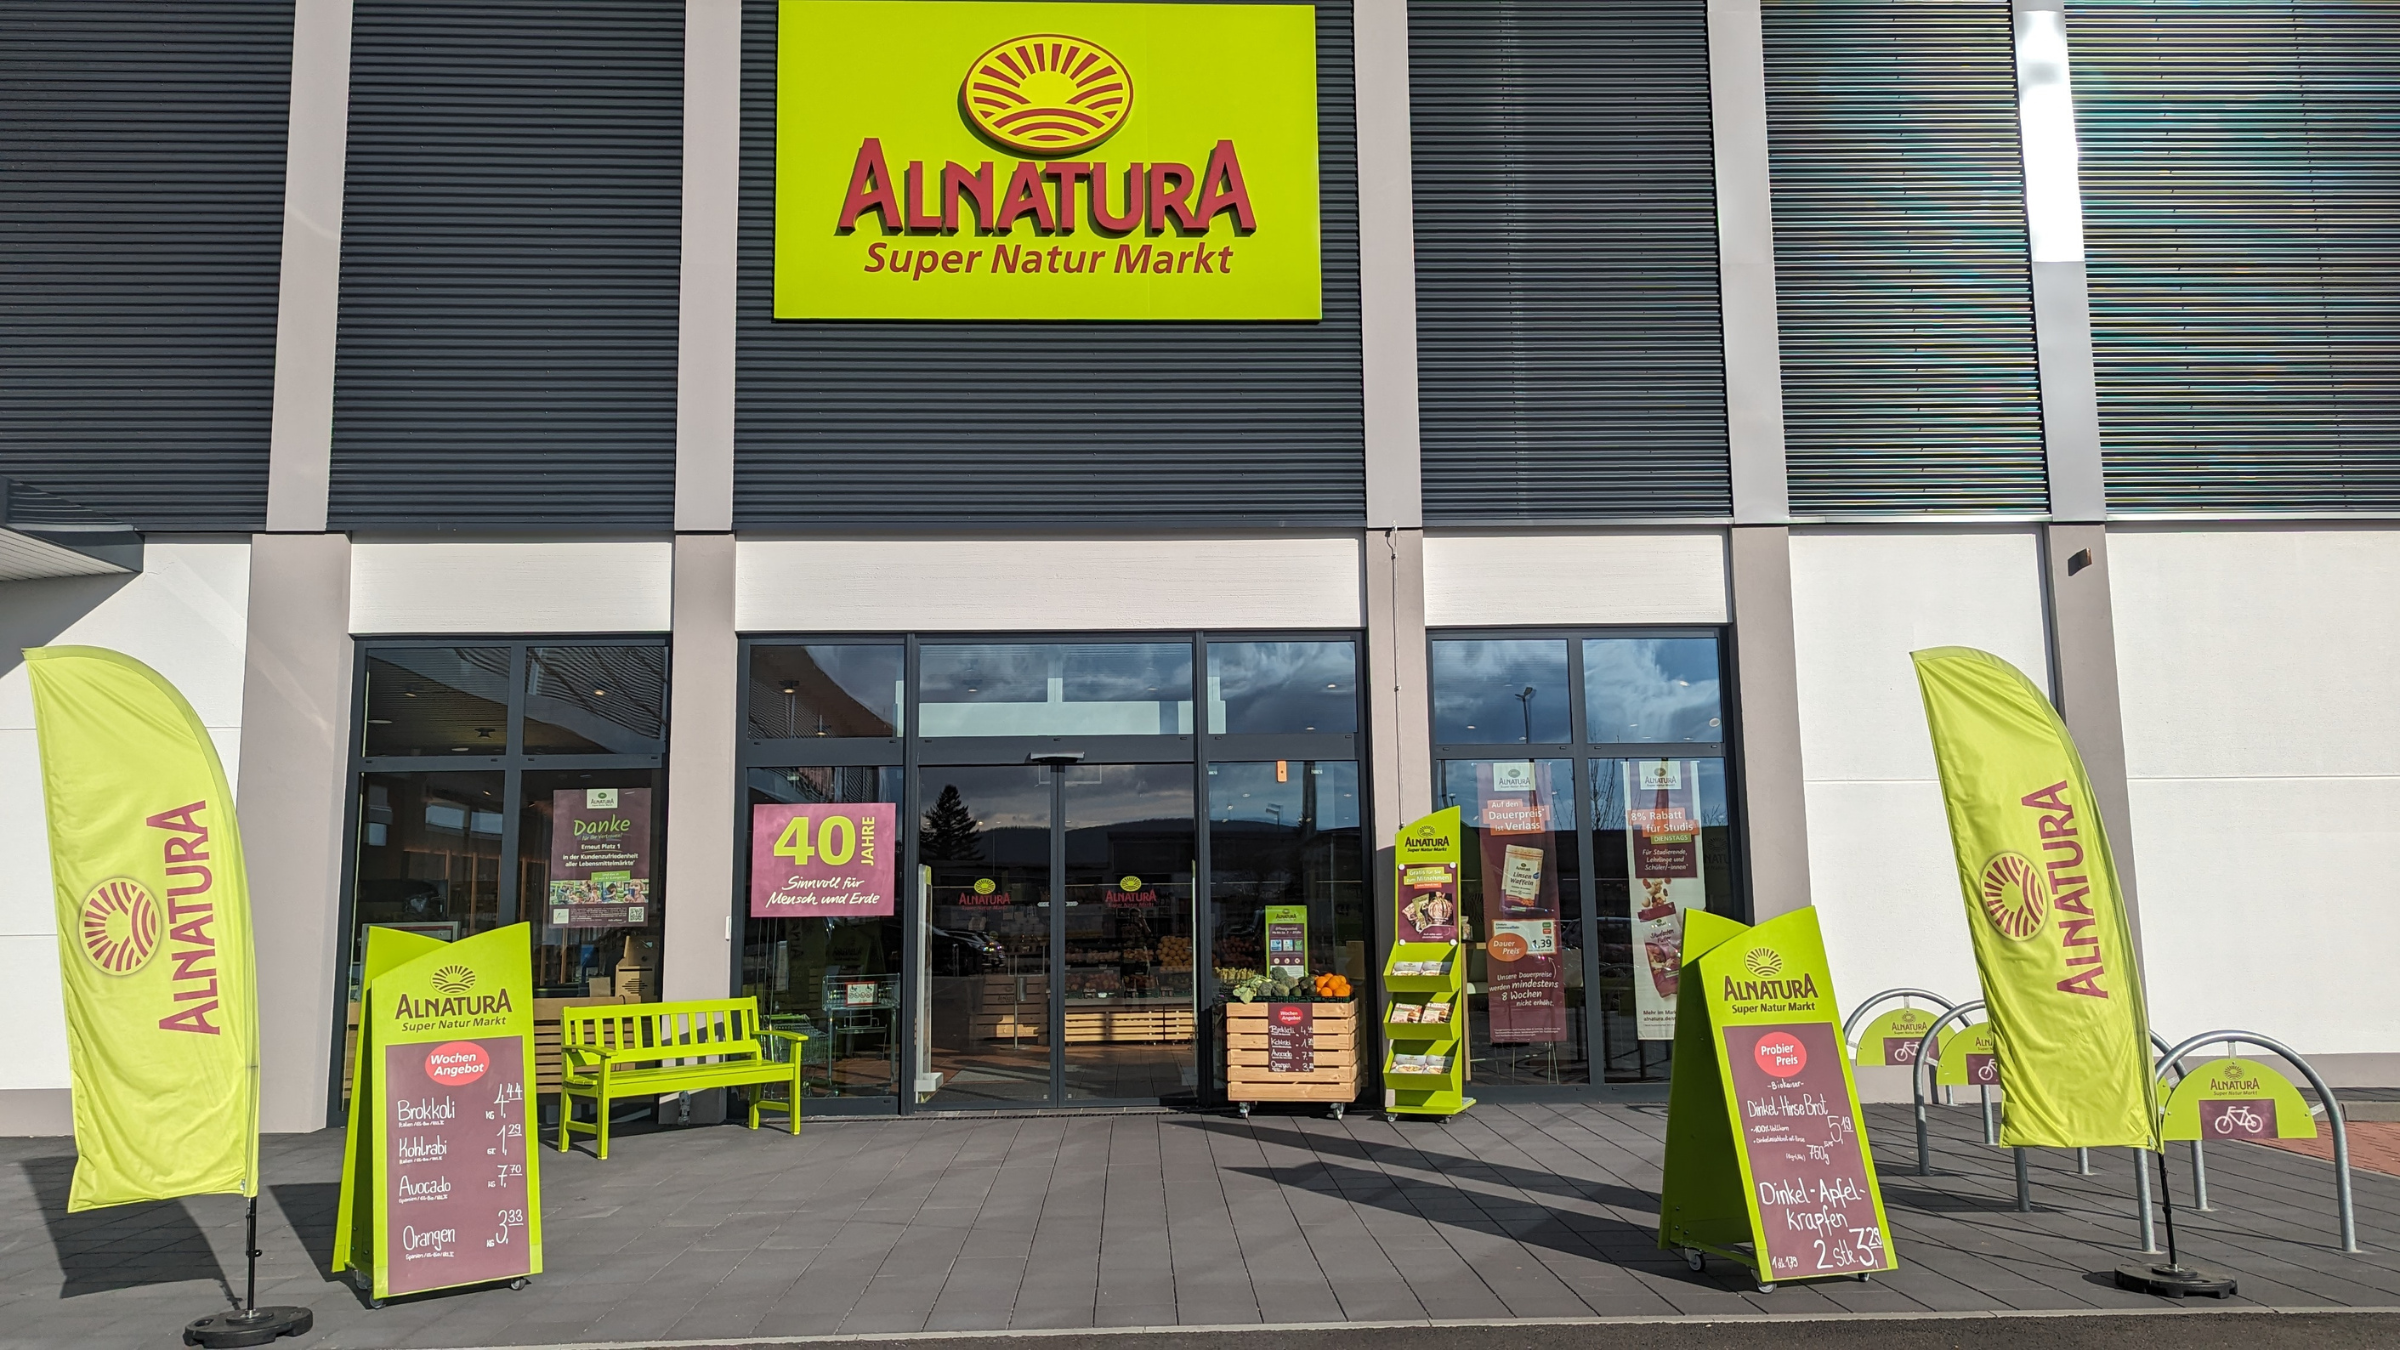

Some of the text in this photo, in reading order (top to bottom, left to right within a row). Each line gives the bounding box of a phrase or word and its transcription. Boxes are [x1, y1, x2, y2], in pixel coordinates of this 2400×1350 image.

[838, 137, 1256, 232] ALNATURA
[865, 242, 1233, 280] Super Natur Markt
[1499, 777, 1530, 785] ALNATURA
[1645, 776, 1676, 784] ALNATURA
[1631, 811, 1682, 821] 8% Rabatt
[574, 814, 630, 836] Danke
[1505, 822, 1540, 831] Verlass
[1646, 823, 1694, 833] für Studis
[774, 815, 875, 866] 40 JAHRE
[1405, 836, 1450, 847] ALNATURA
[782, 876, 865, 890] Sinnvoll für
[1105, 889, 1156, 902] ALNATURA
[2021, 780, 2108, 1000] ALNATURA
[766, 892, 880, 908] Mensch und Erde
[959, 892, 1010, 905] ALNATURA
[146, 800, 220, 1036] ALNATURA
[1532, 939, 1552, 949] 1,39
[1489, 979, 1559, 992] werden mindestens
[1724, 973, 1818, 1001] ALNATURA
[1502, 989, 1542, 1001] 8 Wochen
[395, 988, 512, 1019] ALNATURA
[1732, 1002, 1815, 1015] Super Natur Markt
[402, 1016, 506, 1033] Super Natur Markt
[1892, 1022, 1927, 1031] ALNATURA
[1761, 1043, 1794, 1055] Probier
[430, 1053, 476, 1064] Wochen
[1776, 1055, 1798, 1066] Preis
[434, 1063, 484, 1077] Angebot
[2210, 1078, 2260, 1090] ALNATURA
[397, 1096, 455, 1120] Brokkoli
[399, 1135, 447, 1157] Kohlrabi
[399, 1175, 451, 1196] Avocado
[403, 1225, 455, 1251] Orangen
[1814, 1239, 1833, 1269] 2
